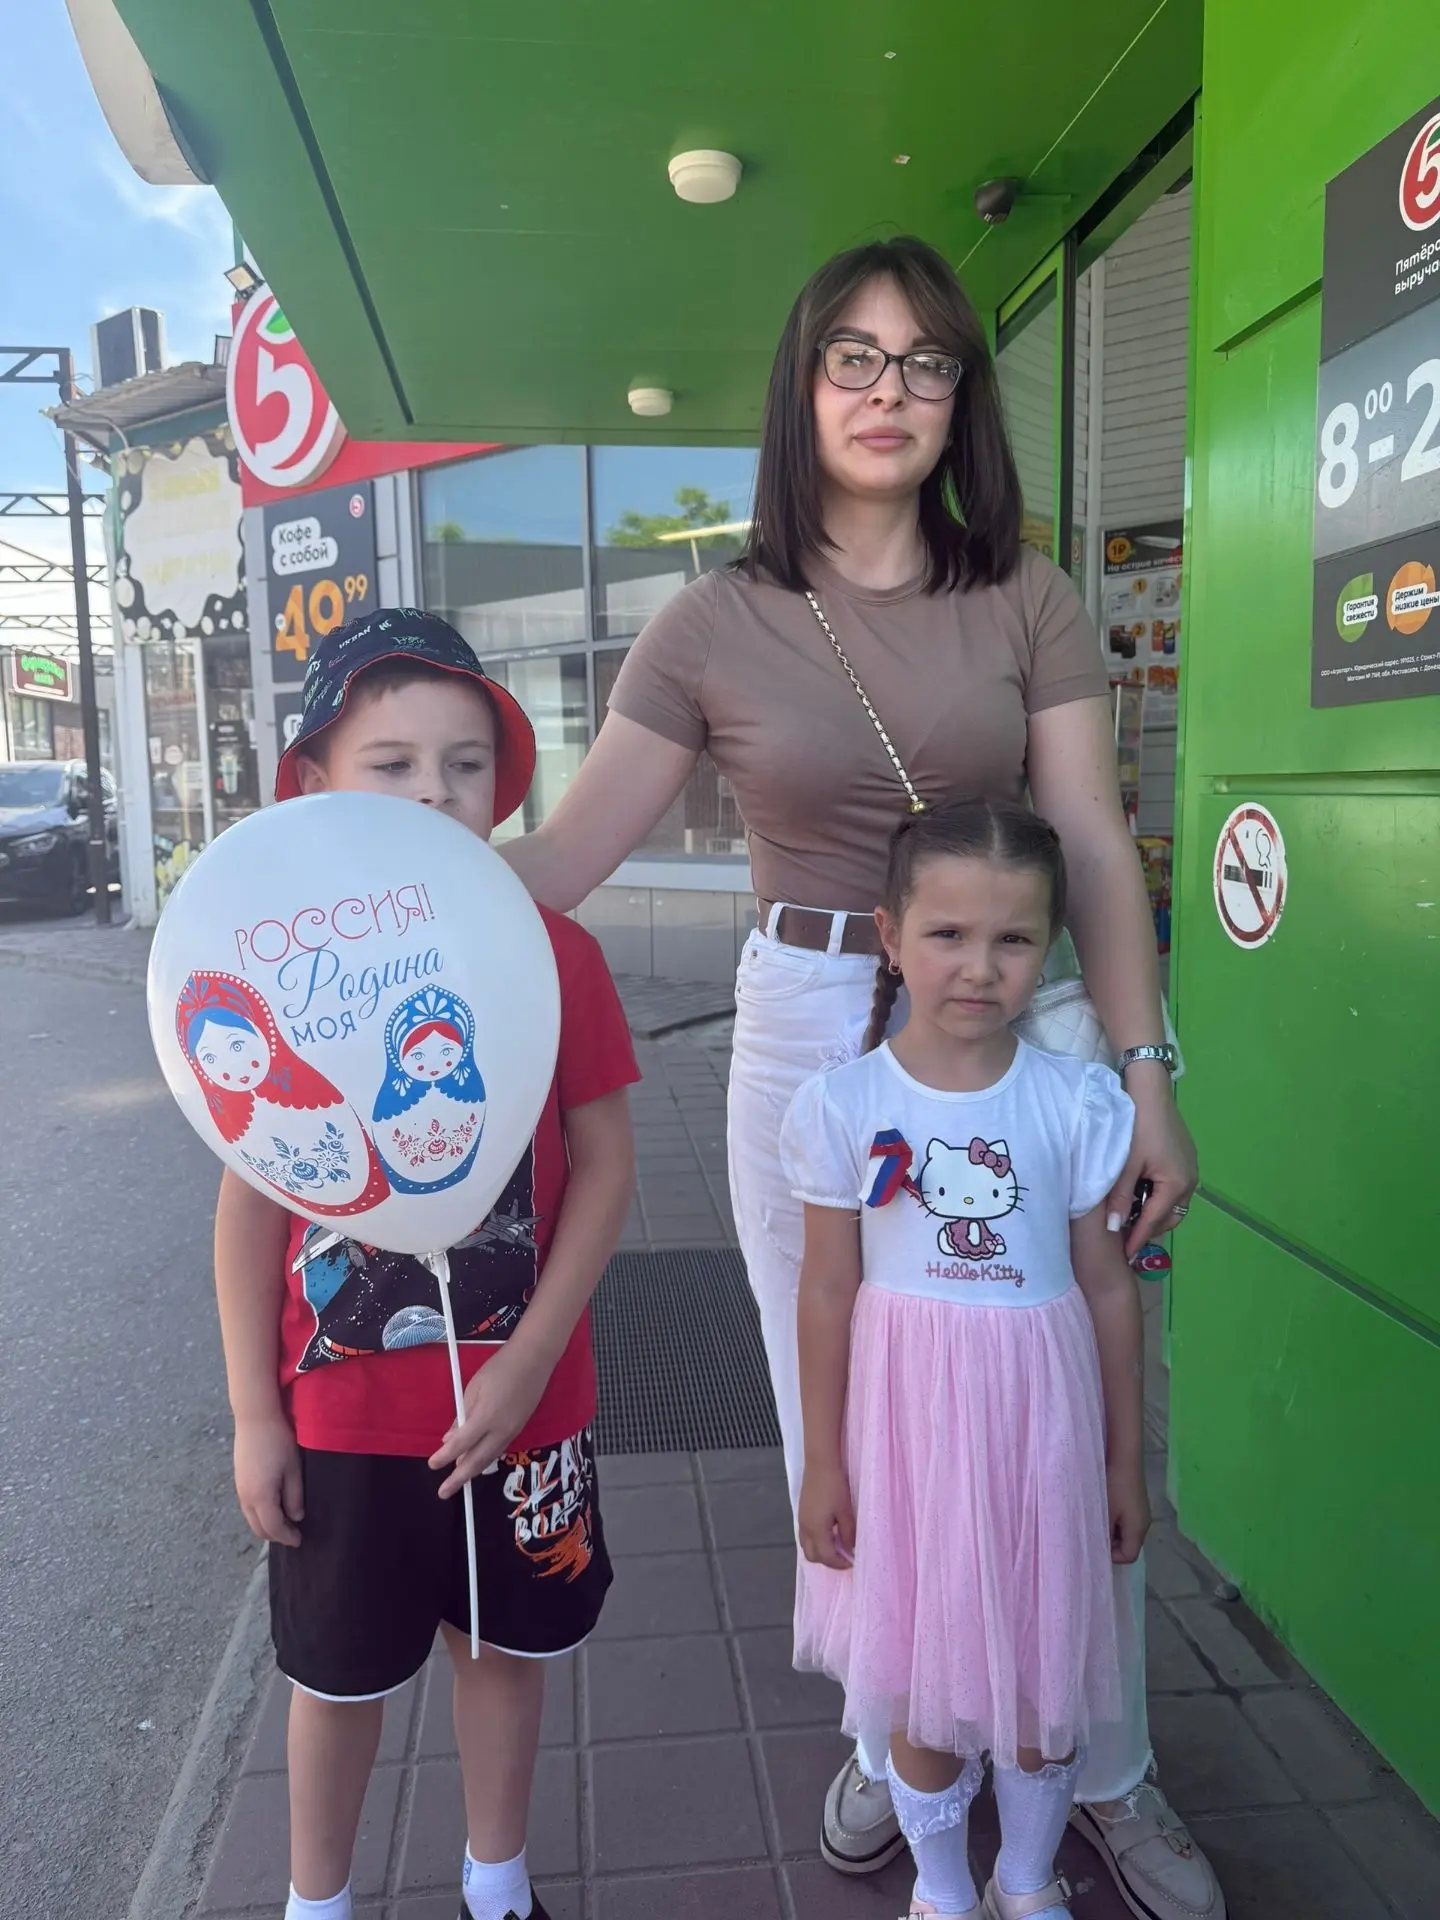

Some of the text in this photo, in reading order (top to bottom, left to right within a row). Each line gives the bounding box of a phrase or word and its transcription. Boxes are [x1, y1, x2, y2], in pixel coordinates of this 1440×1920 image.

[278, 525, 312, 545] Кофе
[280, 542, 329, 566] с собой
[1395, 587, 1424, 601] Держим
[1395, 595, 1440, 612] низкие цены
[1346, 598, 1375, 611] Гарантия
[1346, 610, 1375, 622] свежести
[234, 883, 436, 970] РОССИЯ!
[277, 947, 444, 1020] Родина
[925, 1260, 1026, 1288] Hello Kitty
